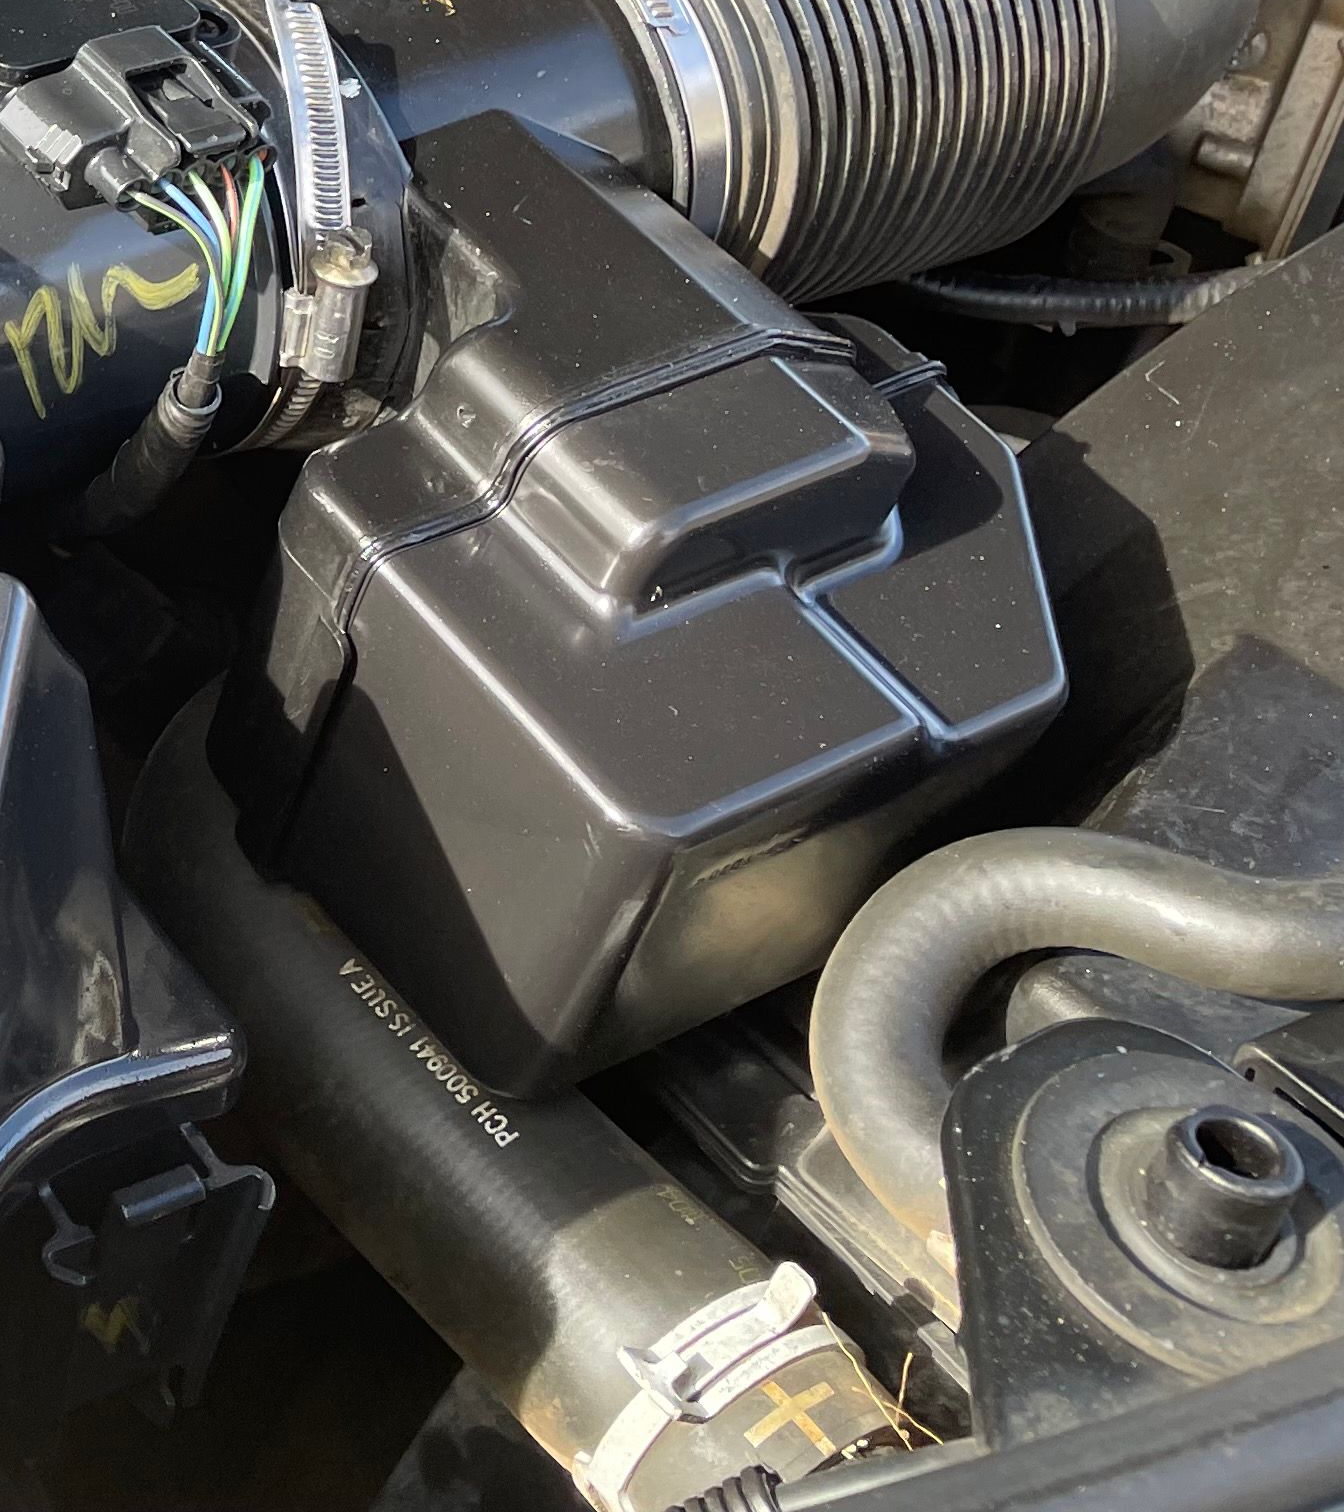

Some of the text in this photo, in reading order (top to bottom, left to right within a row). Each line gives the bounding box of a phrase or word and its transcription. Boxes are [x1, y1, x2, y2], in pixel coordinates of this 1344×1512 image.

[338, 958, 520, 1148] PCH 500941 ISSUE A
